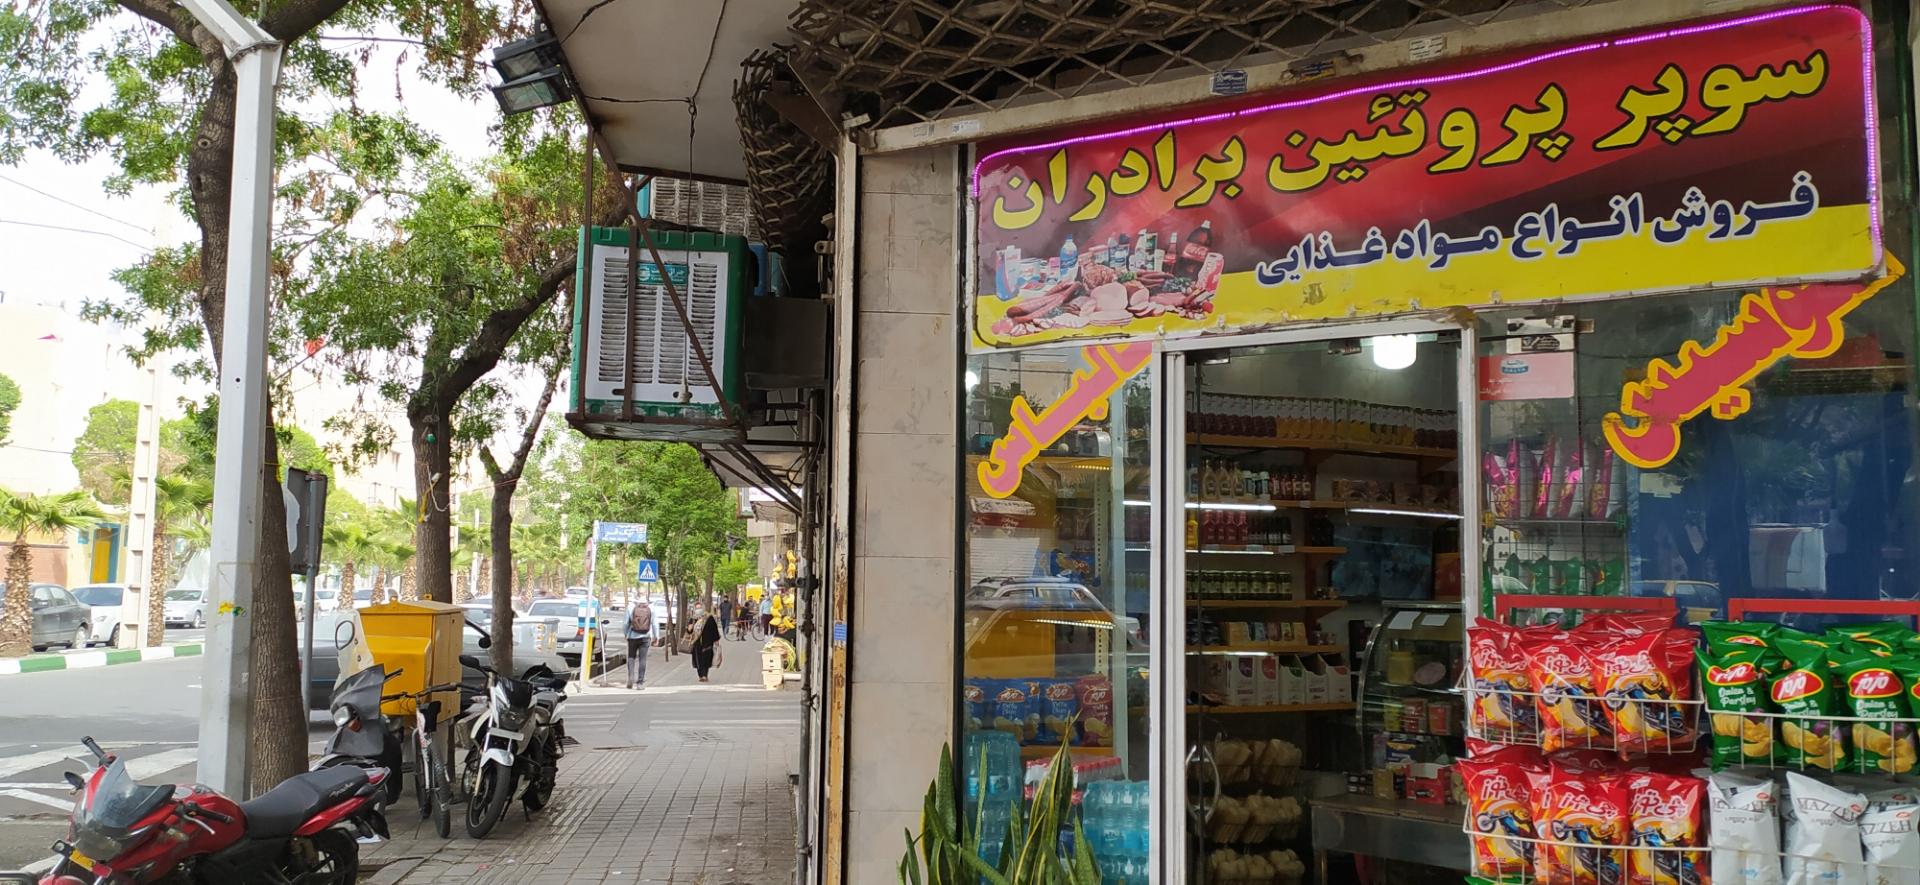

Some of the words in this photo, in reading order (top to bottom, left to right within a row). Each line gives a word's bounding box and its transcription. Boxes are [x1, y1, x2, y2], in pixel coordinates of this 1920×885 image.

[1593, 48, 1831, 151] سوپر
[1267, 82, 1574, 195] پروتئین
[991, 127, 1247, 230] برادران
[1651, 169, 1820, 246] فروش
[1256, 225, 1390, 289] غذایی
[1394, 217, 1502, 273] مواد
[1509, 190, 1645, 263] انواع
